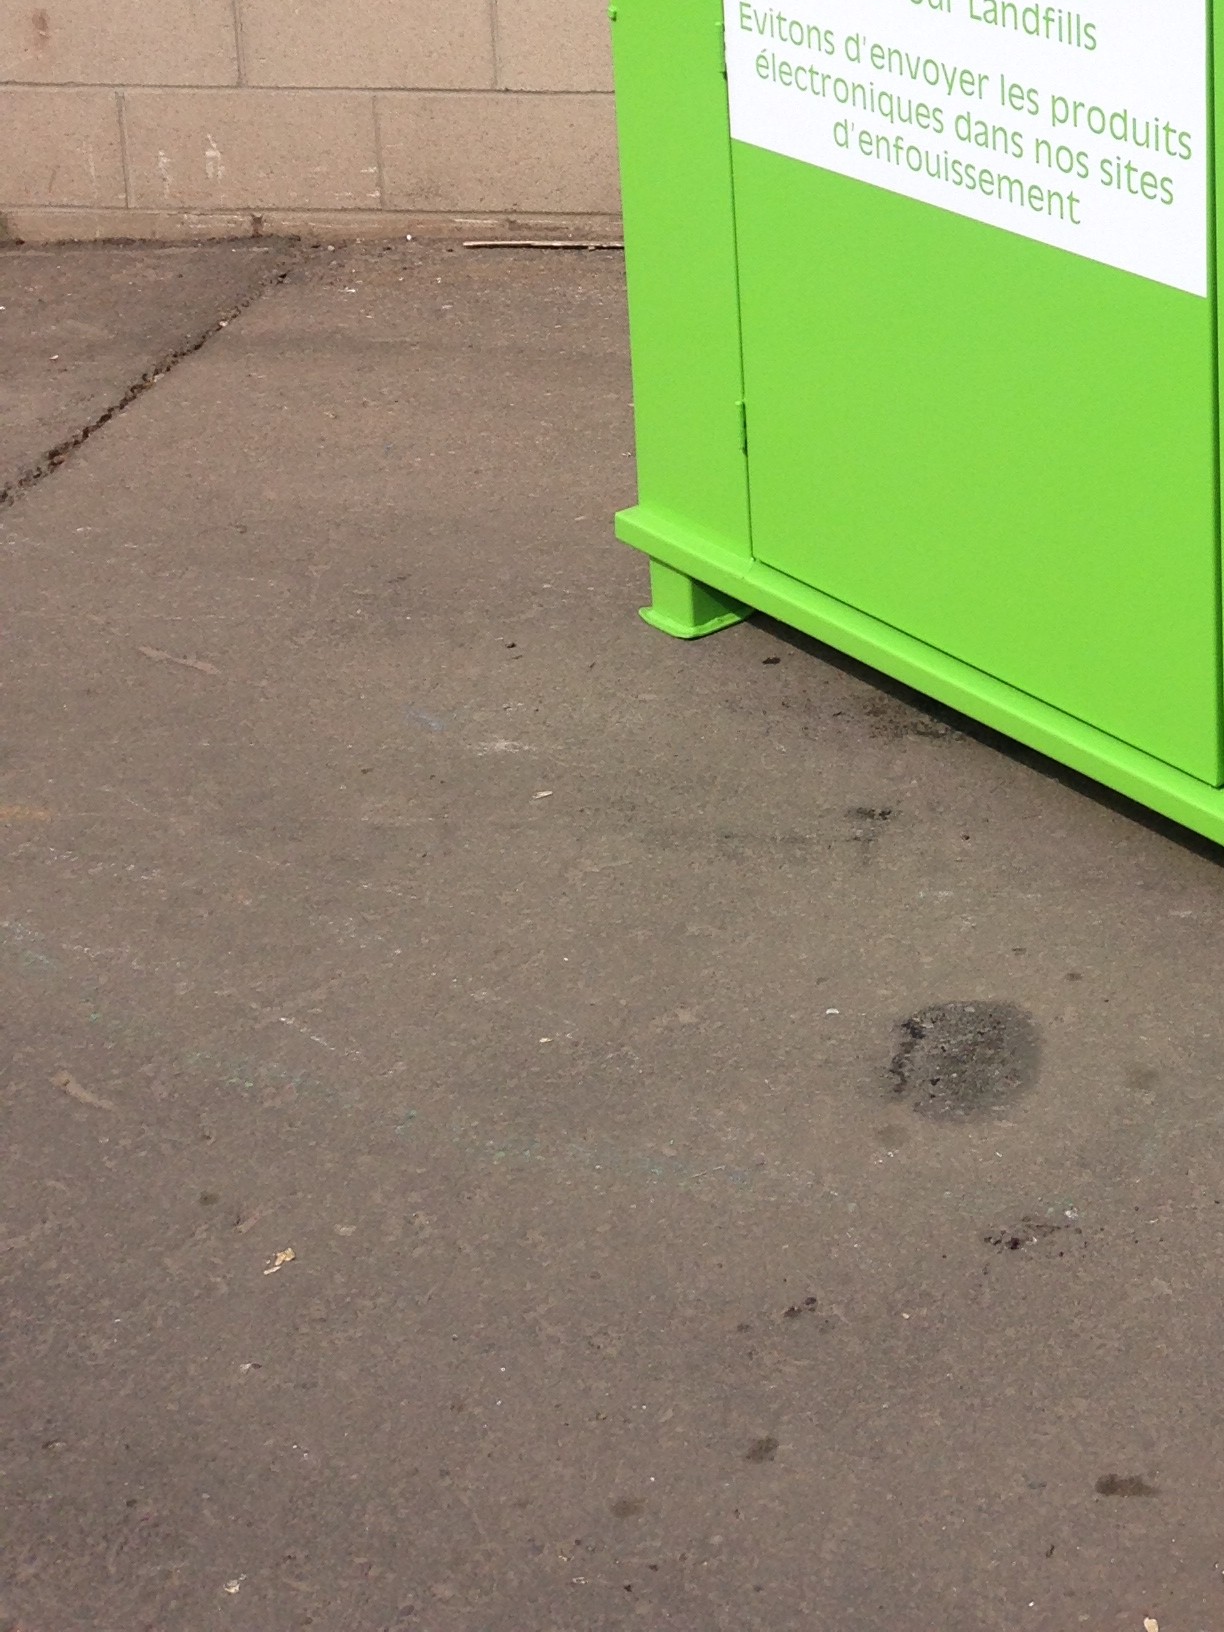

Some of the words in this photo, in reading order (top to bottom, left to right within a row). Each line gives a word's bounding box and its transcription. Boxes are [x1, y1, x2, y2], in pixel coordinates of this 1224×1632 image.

[756, 48, 943, 132] électroniques
[955, 112, 1023, 158] dans
[1035, 137, 1089, 179] nos
[1100, 156, 1174, 205] sites
[845, 34, 989, 100] d'envoyer
[1001, 74, 1039, 115] les
[1052, 92, 1192, 160] produits
[834, 119, 1081, 224] d'enfouissement
